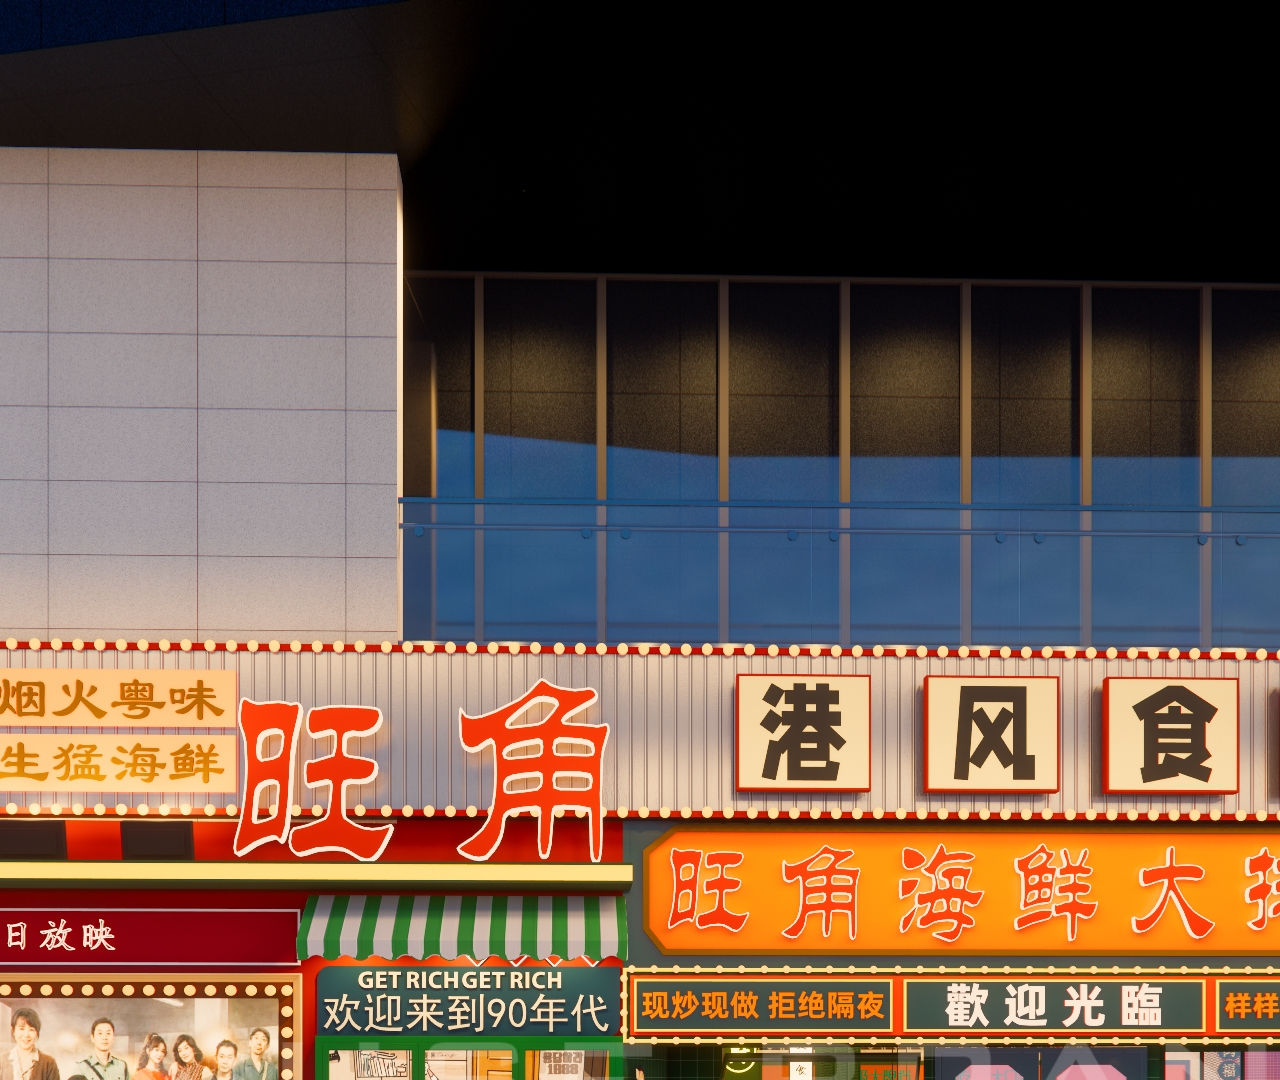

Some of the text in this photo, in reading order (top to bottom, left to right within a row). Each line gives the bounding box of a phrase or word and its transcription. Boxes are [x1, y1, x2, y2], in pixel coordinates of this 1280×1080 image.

[233, 678, 610, 863] 旺角
[358, 971, 401, 989] GET
[510, 971, 562, 989] RICH
[323, 993, 609, 1033] 欢迎来到90年代
[642, 990, 885, 1019] 现炒现做 拒绝隔夜
[945, 983, 1163, 1027] 歡迎光臨
